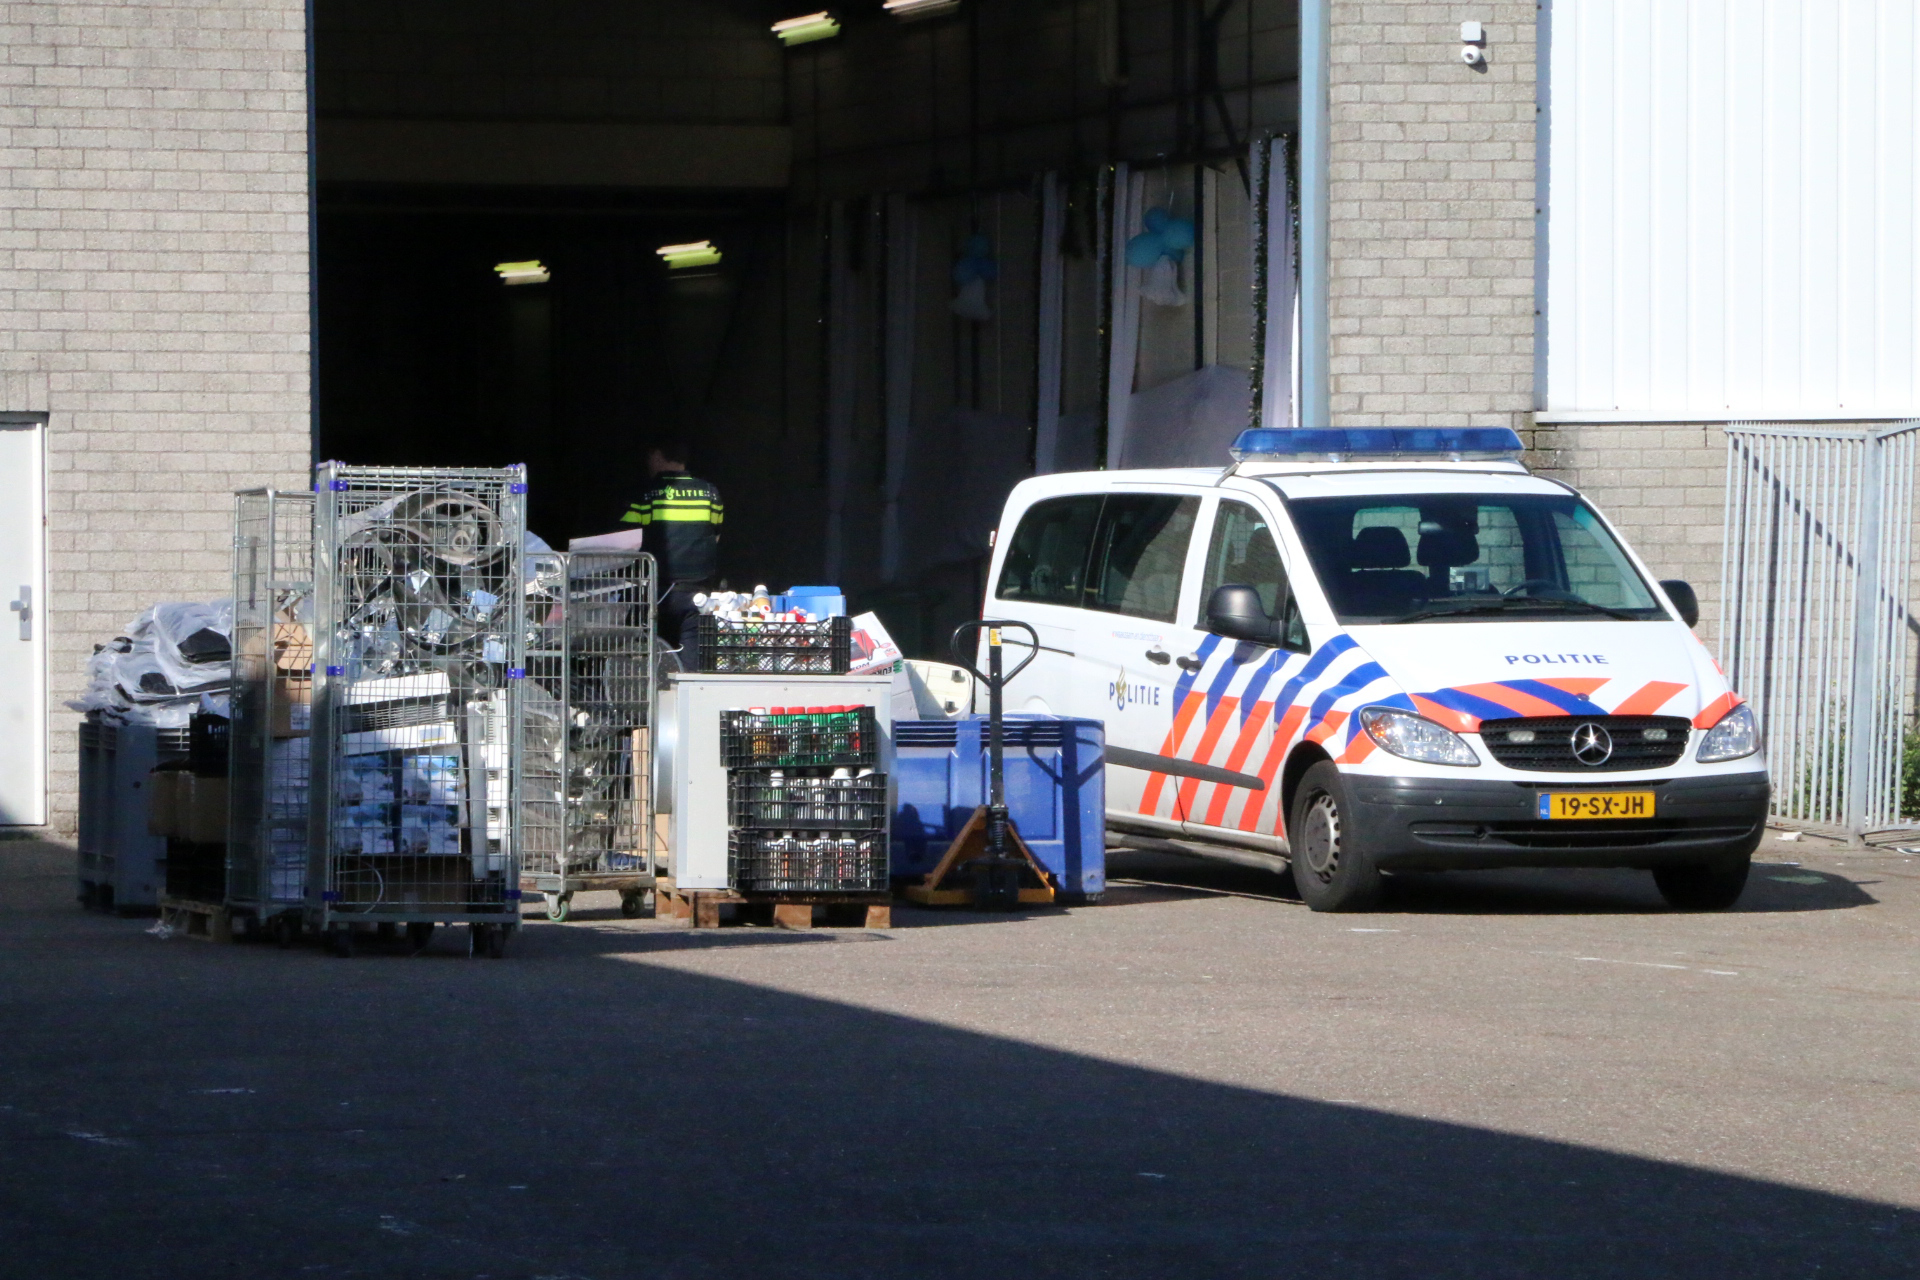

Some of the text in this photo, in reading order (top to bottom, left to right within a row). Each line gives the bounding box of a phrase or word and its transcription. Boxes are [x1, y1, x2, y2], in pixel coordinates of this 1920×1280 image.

[659, 489, 704, 500] POLITIE
[1504, 654, 1609, 664] POLITIE
[1109, 681, 1160, 711] POLITIE
[1560, 796, 1644, 816] 19-SX-JH
